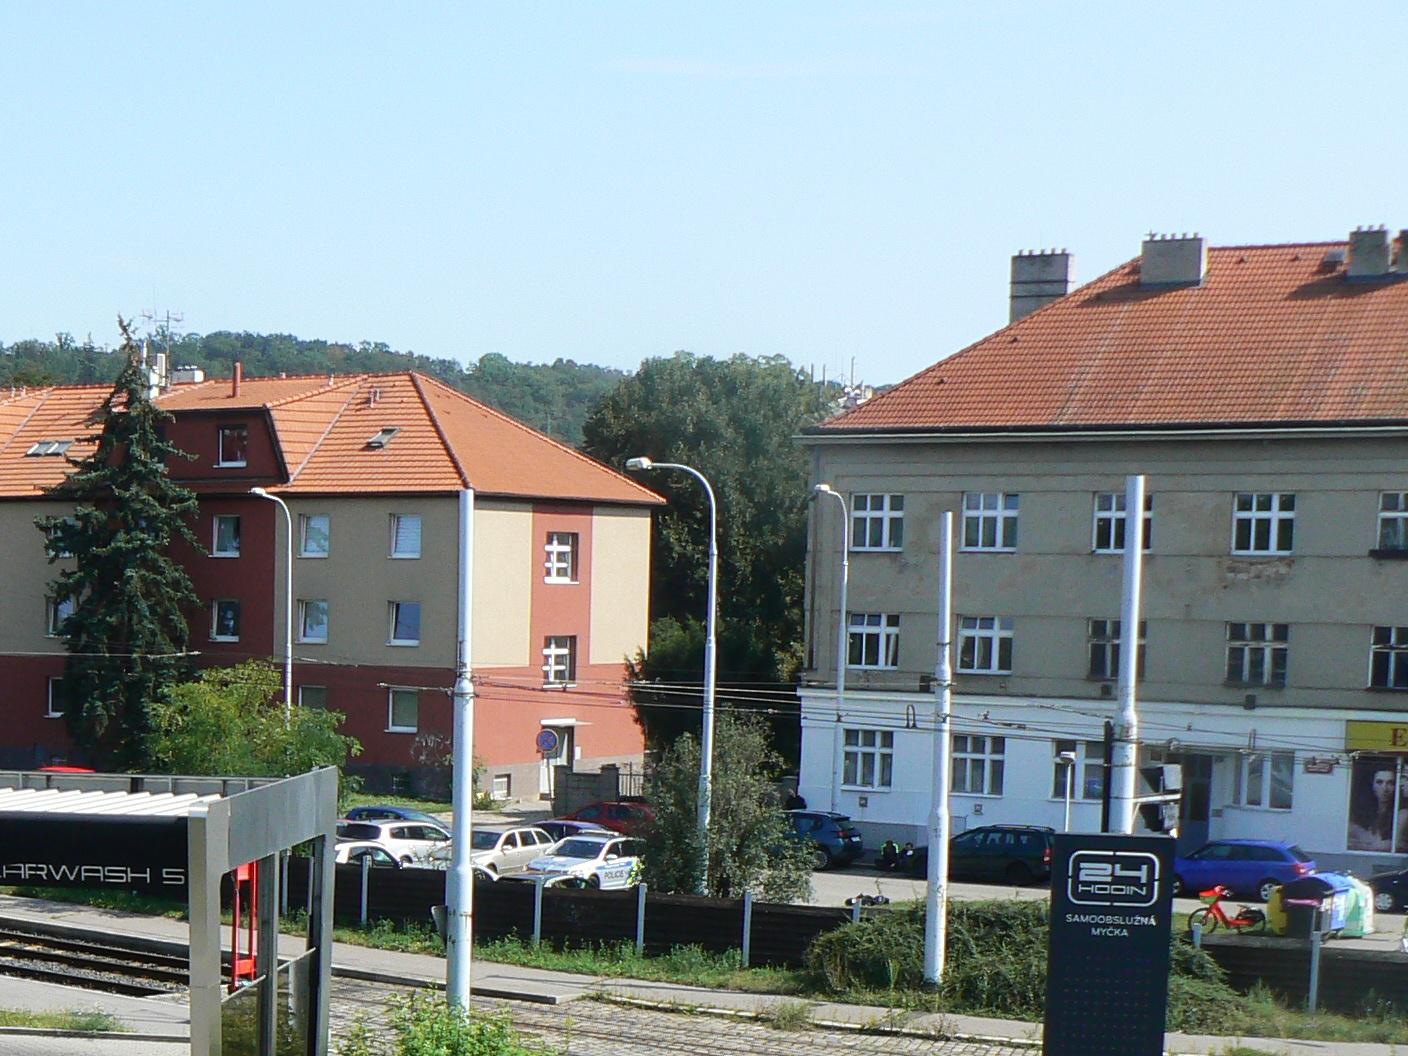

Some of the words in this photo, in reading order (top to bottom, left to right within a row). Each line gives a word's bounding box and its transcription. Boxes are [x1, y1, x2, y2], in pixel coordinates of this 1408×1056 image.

[162, 868, 185, 884] 5
[1079, 862, 1147, 883] 24
[1078, 884, 1146, 896] HODIN
[1065, 913, 1157, 926] SAMOOBSLUŽNÁ
[1091, 926, 1129, 937] MYČKA
